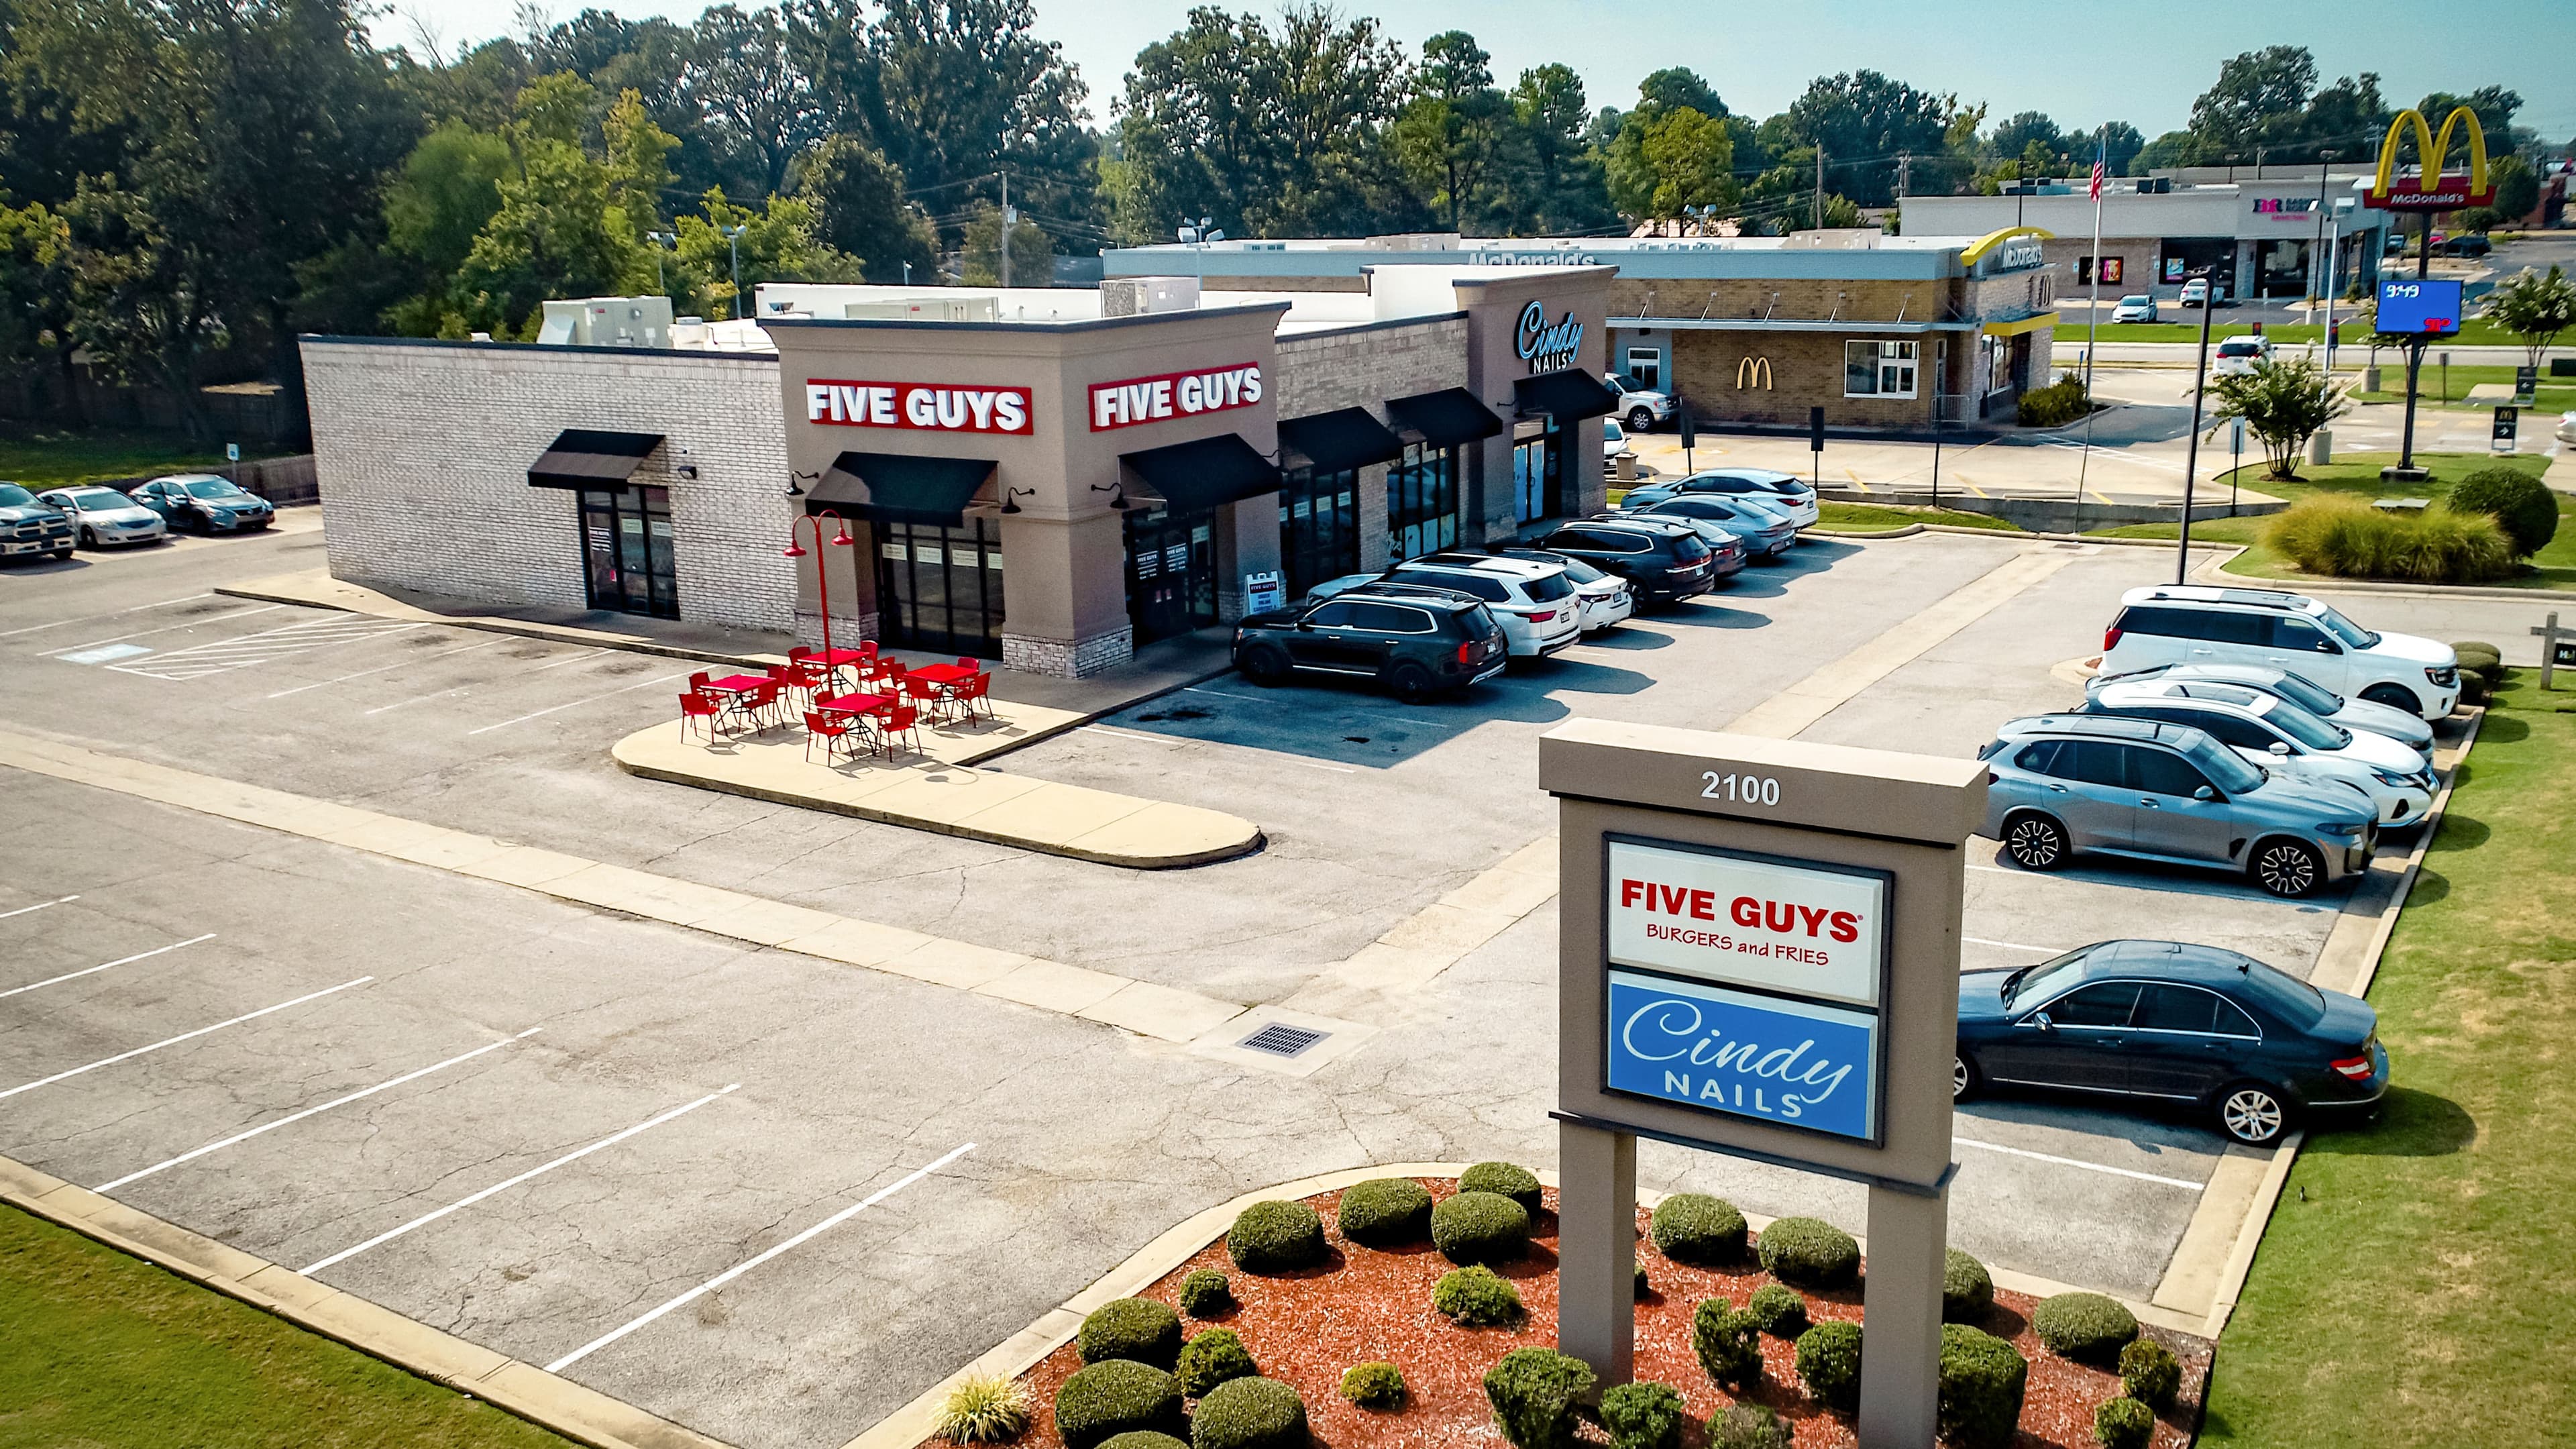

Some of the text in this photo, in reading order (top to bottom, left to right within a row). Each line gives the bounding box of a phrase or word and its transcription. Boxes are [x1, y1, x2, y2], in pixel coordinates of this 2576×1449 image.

[2390, 193, 2465, 205] McDonald's
[2385, 284, 2420, 299] 9:49
[1517, 300, 1584, 364] Cindy
[1533, 352, 1568, 375] NAILS
[806, 384, 1026, 431] FIVE GUYS
[1093, 367, 1262, 427] FIVE GUYS
[1701, 770, 1780, 806] 2100
[1621, 878, 1715, 921] FIVE
[1646, 923, 1829, 966] BURGERS and FRIES
[1622, 999, 1854, 1104] Cindy
[1664, 1069, 1803, 1118] NAILS
